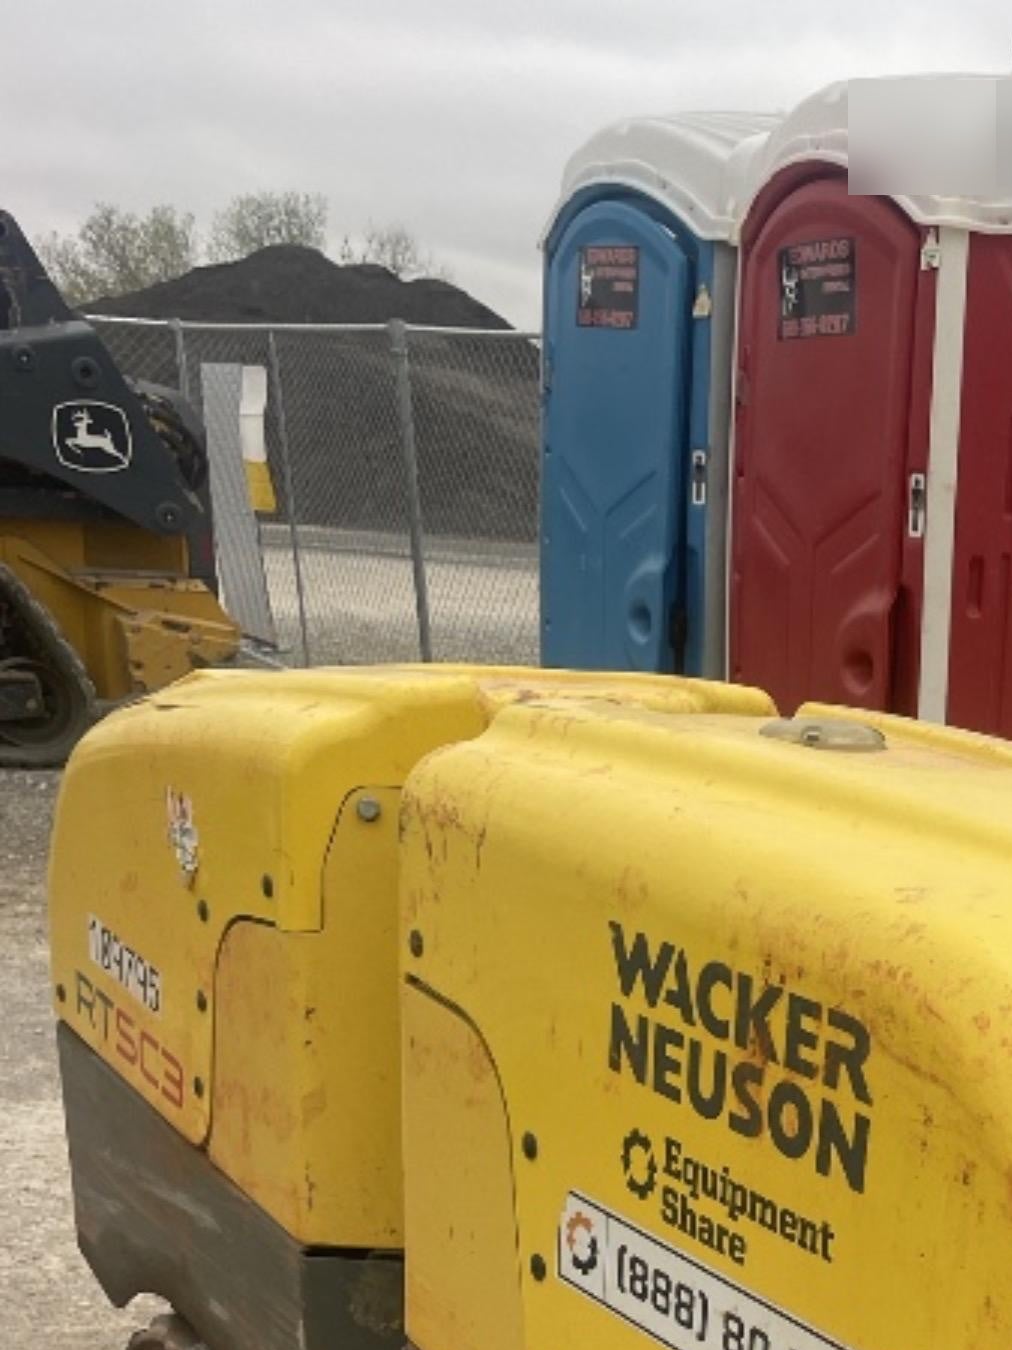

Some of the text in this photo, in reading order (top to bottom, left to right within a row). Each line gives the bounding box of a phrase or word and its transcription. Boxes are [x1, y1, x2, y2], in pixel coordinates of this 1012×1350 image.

[608, 920, 873, 1106] WACKER
[608, 1002, 871, 1194] NEUSON
[660, 1185, 747, 1266] Share
[662, 1136, 835, 1263] Equipment
[616, 1244, 709, 1342] (888)
